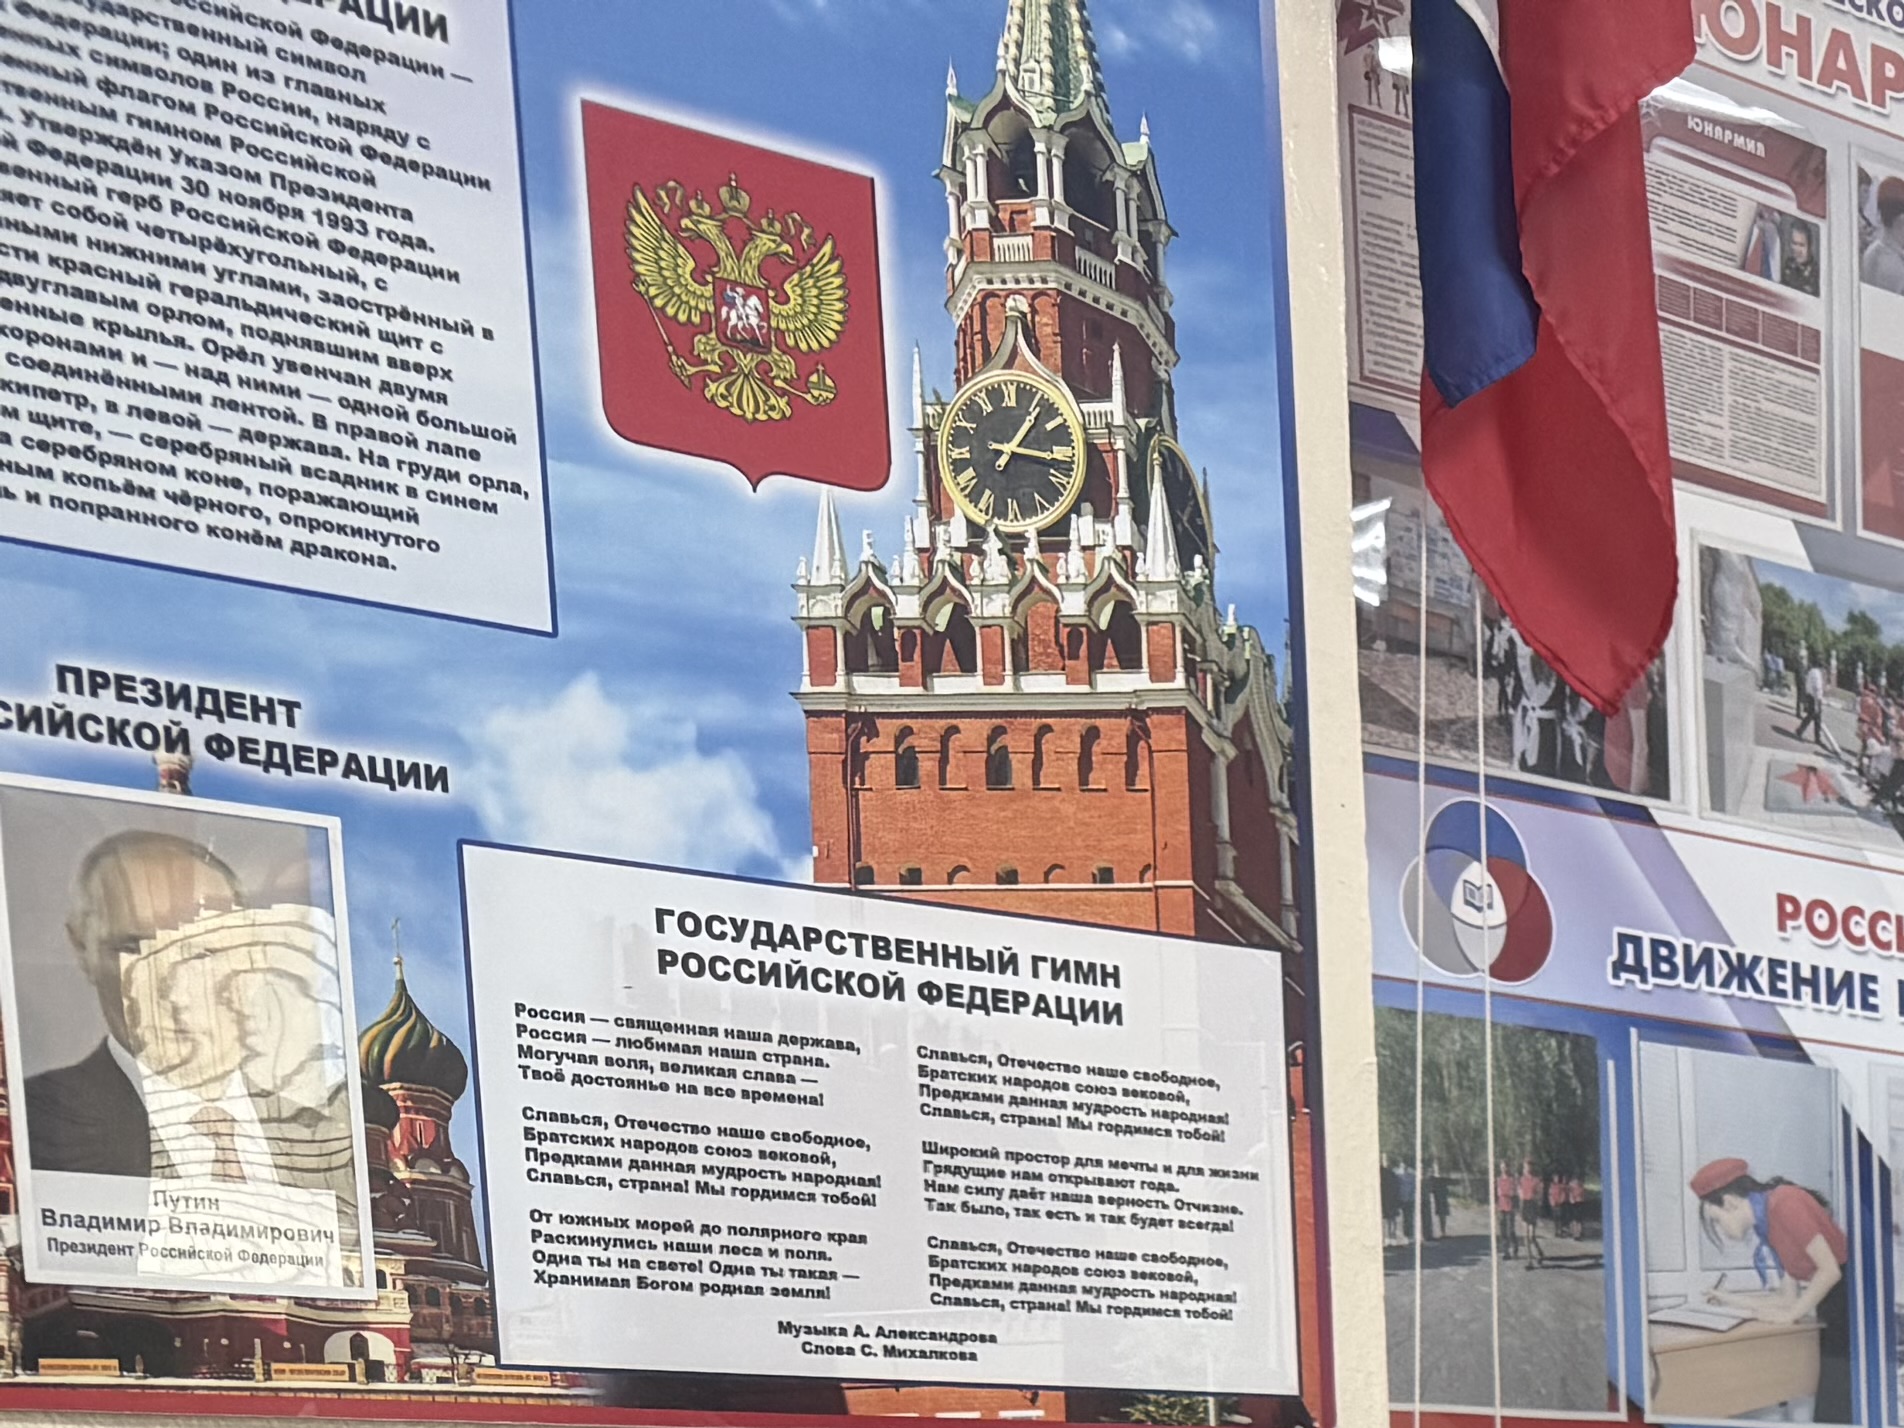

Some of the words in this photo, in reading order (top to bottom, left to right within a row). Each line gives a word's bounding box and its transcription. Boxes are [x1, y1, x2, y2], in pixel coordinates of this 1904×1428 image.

[1688, 115, 1766, 158] ЮНАРМИЯ
[5, 352, 203, 406] соединёнными
[210, 395, 305, 427] лентой.
[312, 412, 328, 431] В
[335, 421, 419, 450] правой
[425, 440, 481, 462] лапе
[0, 378, 97, 414] кипетр,
[105, 399, 119, 414] в
[126, 404, 202, 432] левой
[238, 427, 351, 462] держава.
[358, 447, 390, 469] На
[396, 459, 461, 484] груди
[468, 473, 529, 500] орла,
[21, 435, 177, 479] серебряном
[185, 467, 252, 496] коне,
[259, 482, 420, 526] поражающий
[27, 410, 102, 441] щите,
[139, 432, 293, 475] серебряный
[300, 464, 399, 496] всадник
[405, 485, 418, 499] в
[425, 489, 498, 515] синем
[25, 490, 42, 506] и
[49, 494, 199, 534] попранного
[206, 524, 283, 550] конём
[290, 539, 397, 571] дракона.
[62, 470, 156, 501] копьём
[163, 489, 271, 526] чёрного,
[279, 512, 440, 553] опрокинутого
[56, 664, 301, 728] ПРЕЗИДЕНТ
[0, 702, 190, 755] СИЙСКОЙ
[205, 733, 449, 793] ФЕДЕРАЦИИ
[655, 907, 1019, 977] ГОСУДАРСТВЕННЫЙ
[1031, 955, 1121, 989] ГИМН
[657, 949, 905, 1002] РОССИЙСКОЙ
[917, 980, 1123, 1027] ФЕДЕРАЦИИ
[1613, 934, 1879, 1014] ДВИЖЕНИЕ
[514, 1002, 585, 1024] Россия
[614, 1017, 719, 1038] священная
[724, 1028, 773, 1043] наша
[777, 1034, 861, 1056] держава,
[516, 1023, 587, 1044] Россия
[615, 1036, 702, 1056] любимая
[708, 1046, 757, 1061] наша
[762, 1052, 830, 1068] страна.
[517, 1044, 598, 1066] Могучая
[605, 1056, 654, 1075] воля,
[660, 1061, 737, 1080] великая
[742, 1070, 796, 1084] слава
[518, 1064, 565, 1082] Твоё
[571, 1073, 670, 1092] достоянье
[675, 1082, 698, 1095] на
[704, 1085, 736, 1098] все
[741, 1089, 824, 1107] времена!
[522, 1106, 609, 1131] Славься,
[614, 1114, 711, 1135] Отечество
[717, 1126, 765, 1140] наше
[770, 1130, 871, 1152] свободное,
[523, 1126, 615, 1148] Братских
[620, 1138, 699, 1156] народов
[704, 1145, 753, 1159] союз
[758, 1149, 837, 1169] вековой,
[525, 1147, 622, 1169] Предками
[628, 1158, 696, 1175] данная
[702, 1164, 787, 1182] мудрость
[791, 1171, 881, 1189] народная!
[526, 1168, 613, 1191] Славься,
[619, 1178, 689, 1194] страна!
[695, 1180, 725, 1196] Мы
[730, 1186, 816, 1203] гордимся
[821, 1191, 876, 1207] тобой!
[153, 1190, 219, 1212] Путин
[41, 1208, 160, 1235] Владимир
[168, 1216, 334, 1244] Владимирович
[47, 1238, 134, 1257] Президент
[139, 1243, 232, 1262] Российской
[238, 1250, 323, 1267] Федерации
[777, 1320, 848, 1339] Музыка
[853, 1324, 870, 1338] А.
[875, 1325, 997, 1346] Александрова
[801, 1341, 856, 1356] Слова
[860, 1344, 878, 1357] С.
[883, 1344, 978, 1362] Михалкова
